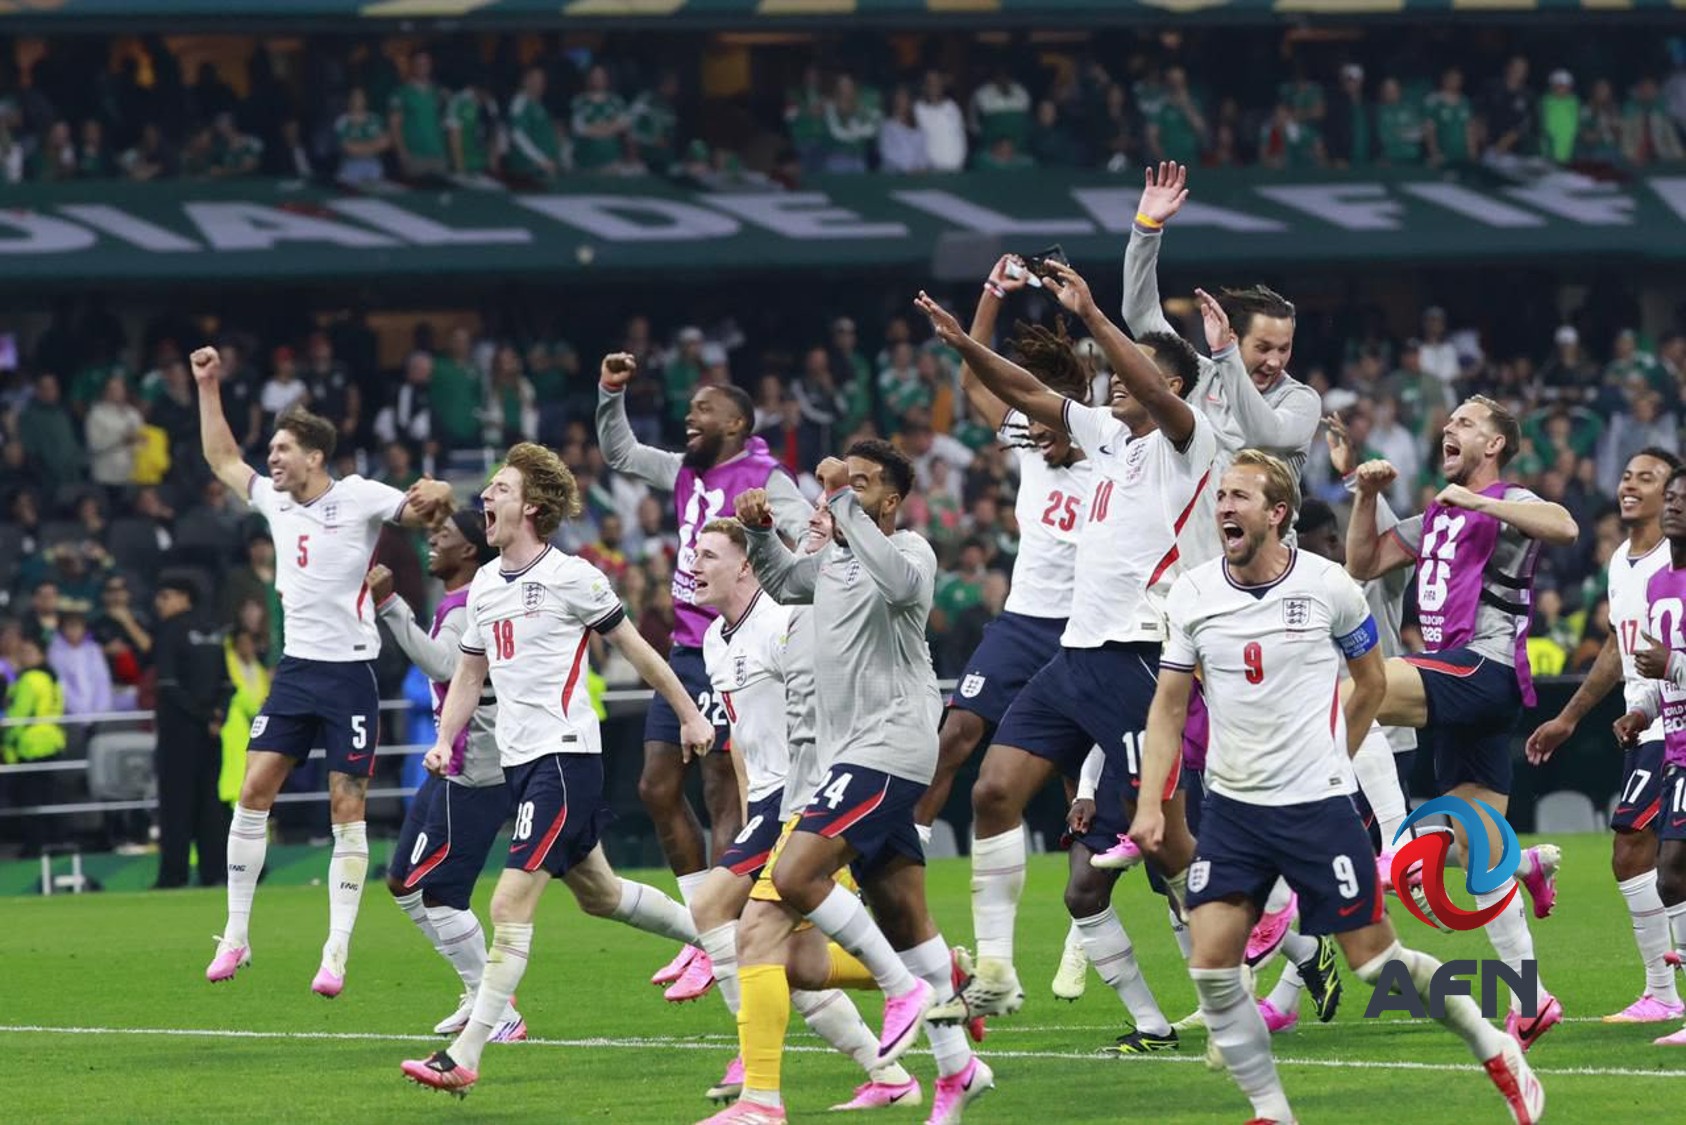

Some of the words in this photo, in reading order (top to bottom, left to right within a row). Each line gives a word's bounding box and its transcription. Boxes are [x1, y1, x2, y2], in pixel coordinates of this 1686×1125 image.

[521, 193, 907, 240] DE
[889, 186, 1287, 236] LA
[1255, 178, 1686, 228] FIE
[1041, 490, 1081, 532] 25
[1089, 480, 1115, 522] 10
[297, 534, 310, 568] 5
[493, 617, 515, 660] 18
[1621, 619, 1638, 655] 17
[1243, 641, 1264, 685] 9
[698, 691, 728, 726] 22
[351, 714, 367, 749] 5
[808, 770, 853, 810] 24
[1621, 769, 1652, 804] 17
[512, 801, 535, 841] 18
[734, 814, 764, 844] 8
[229, 864, 246, 873] ENG
[340, 882, 359, 891] ENG
[1332, 855, 1359, 899] 9
